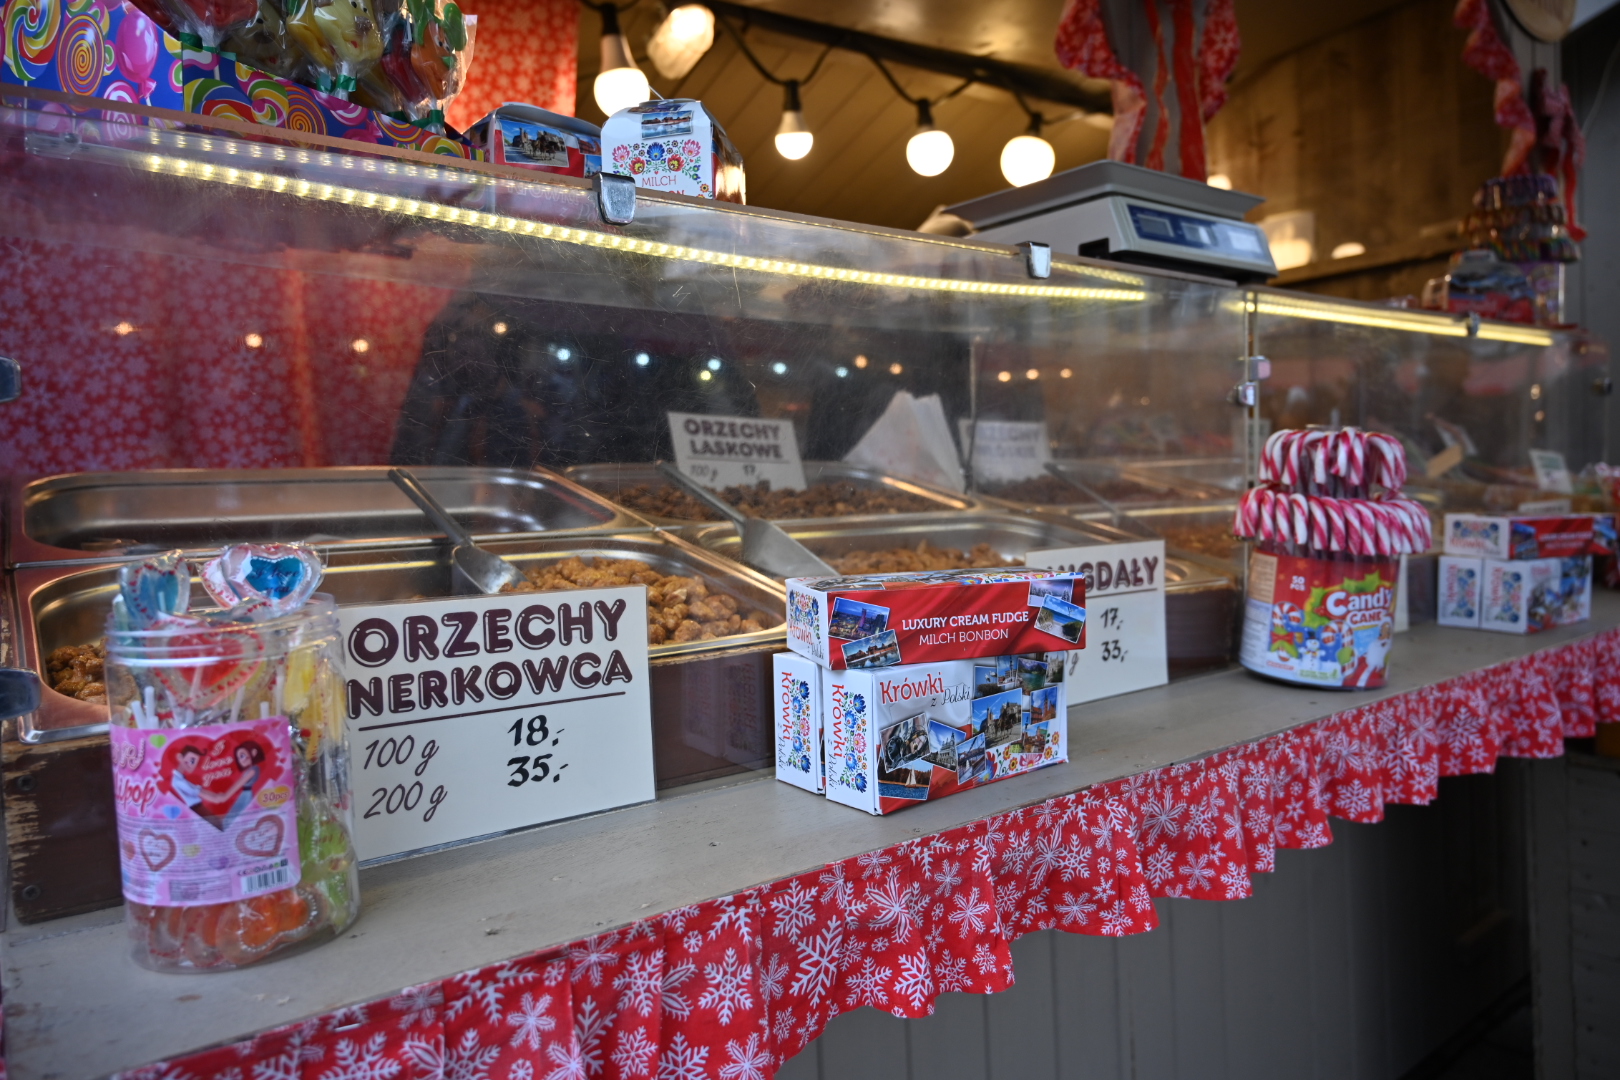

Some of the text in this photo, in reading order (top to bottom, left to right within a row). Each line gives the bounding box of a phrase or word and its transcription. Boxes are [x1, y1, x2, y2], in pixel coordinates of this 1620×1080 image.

[642, 175, 677, 188] MILCH
[684, 418, 780, 440] ORZECHY
[690, 439, 783, 459] LASKOWE
[1046, 555, 1159, 593] GDAŁY
[348, 599, 626, 668] ORZECHY
[902, 611, 1029, 631] LUXURY CREAM FUDGE
[1350, 611, 1384, 625] CANE
[919, 628, 1009, 646] MILCH BONBON
[347, 649, 633, 720] NERKOWCA
[879, 672, 945, 704] Krówki
[930, 684, 972, 707] z Polski
[781, 671, 793, 740] Krówki
[832, 684, 846, 758] Krówki
[363, 734, 440, 777] 100 g
[363, 780, 448, 823] 200 g
